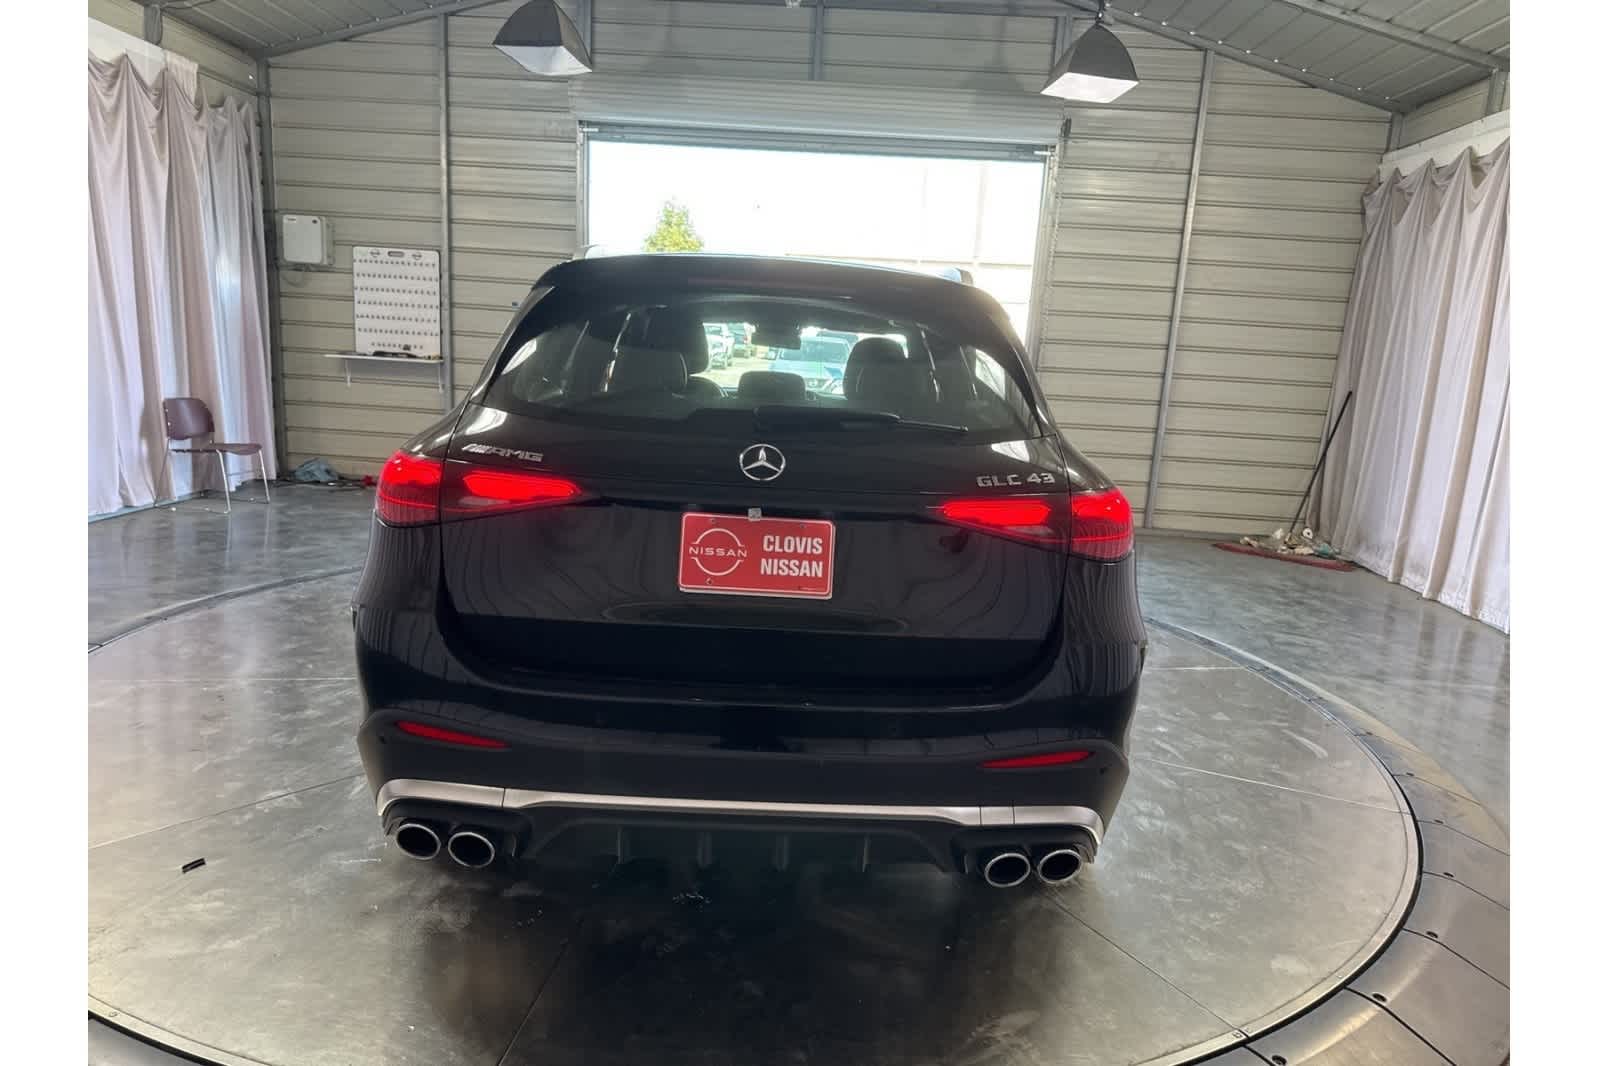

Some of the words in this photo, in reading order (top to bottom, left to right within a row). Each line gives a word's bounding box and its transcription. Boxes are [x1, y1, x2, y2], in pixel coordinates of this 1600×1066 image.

[475, 445, 544, 462] AMG
[976, 474, 1022, 487] GLC
[1027, 472, 1056, 484] 43
[689, 546, 747, 558] NISSAN
[763, 535, 823, 555] CLOVIS
[760, 558, 823, 577] NISSAN
